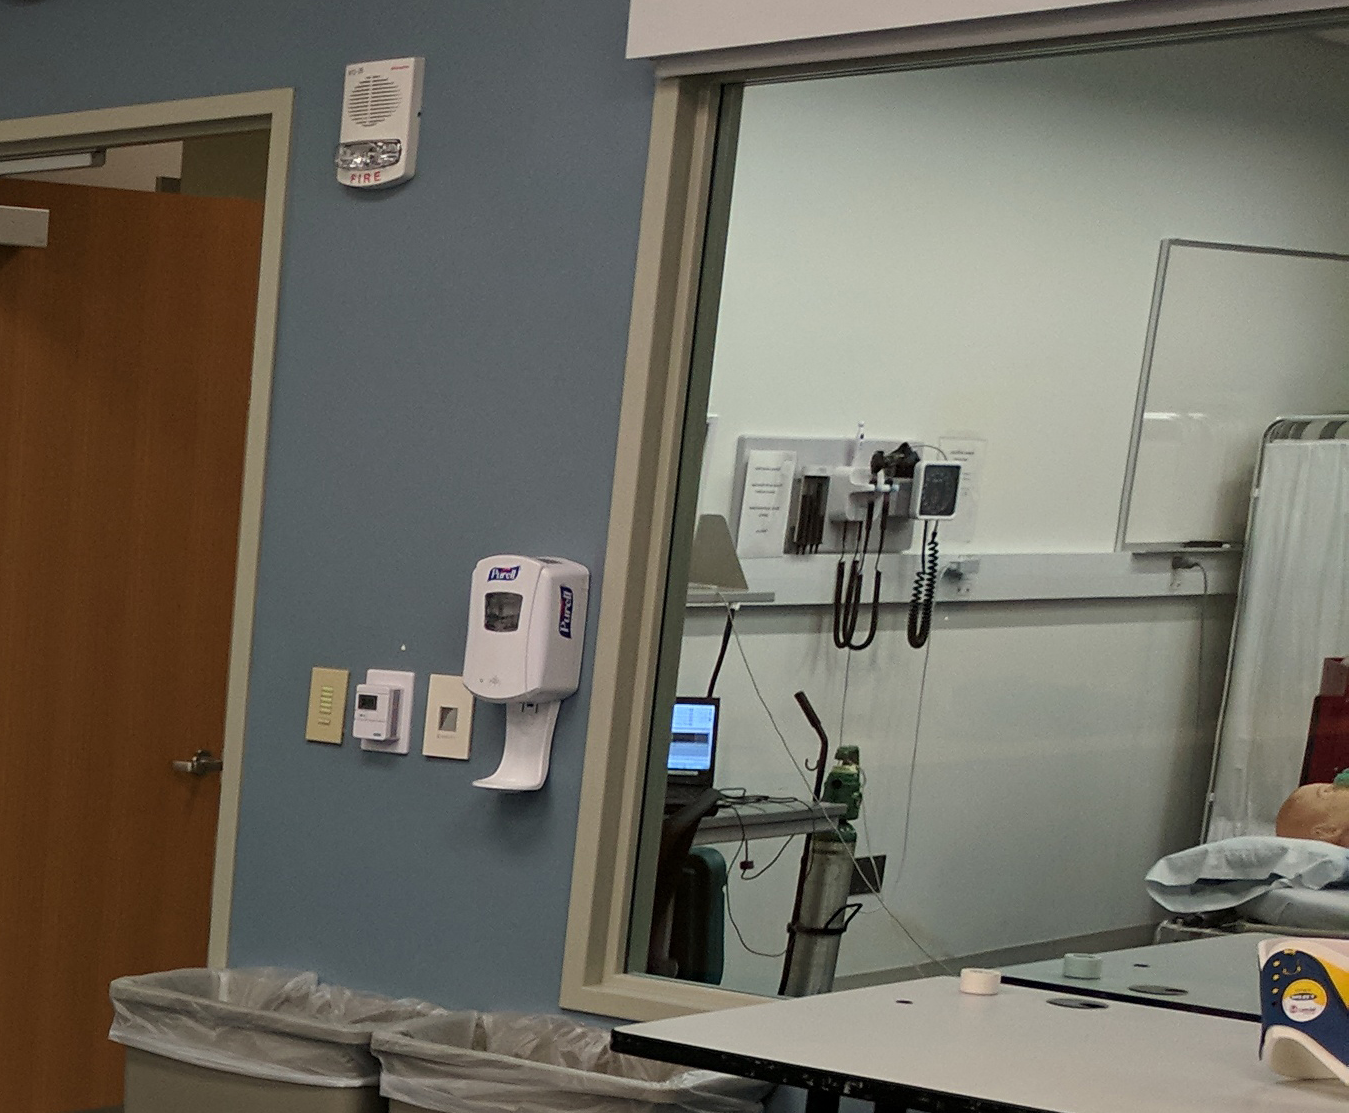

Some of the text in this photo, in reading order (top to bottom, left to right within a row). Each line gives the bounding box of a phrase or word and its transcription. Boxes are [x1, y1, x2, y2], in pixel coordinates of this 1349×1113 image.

[349, 171, 381, 184] FIRE
[490, 567, 518, 580] Purell
[560, 589, 573, 634] Purell
